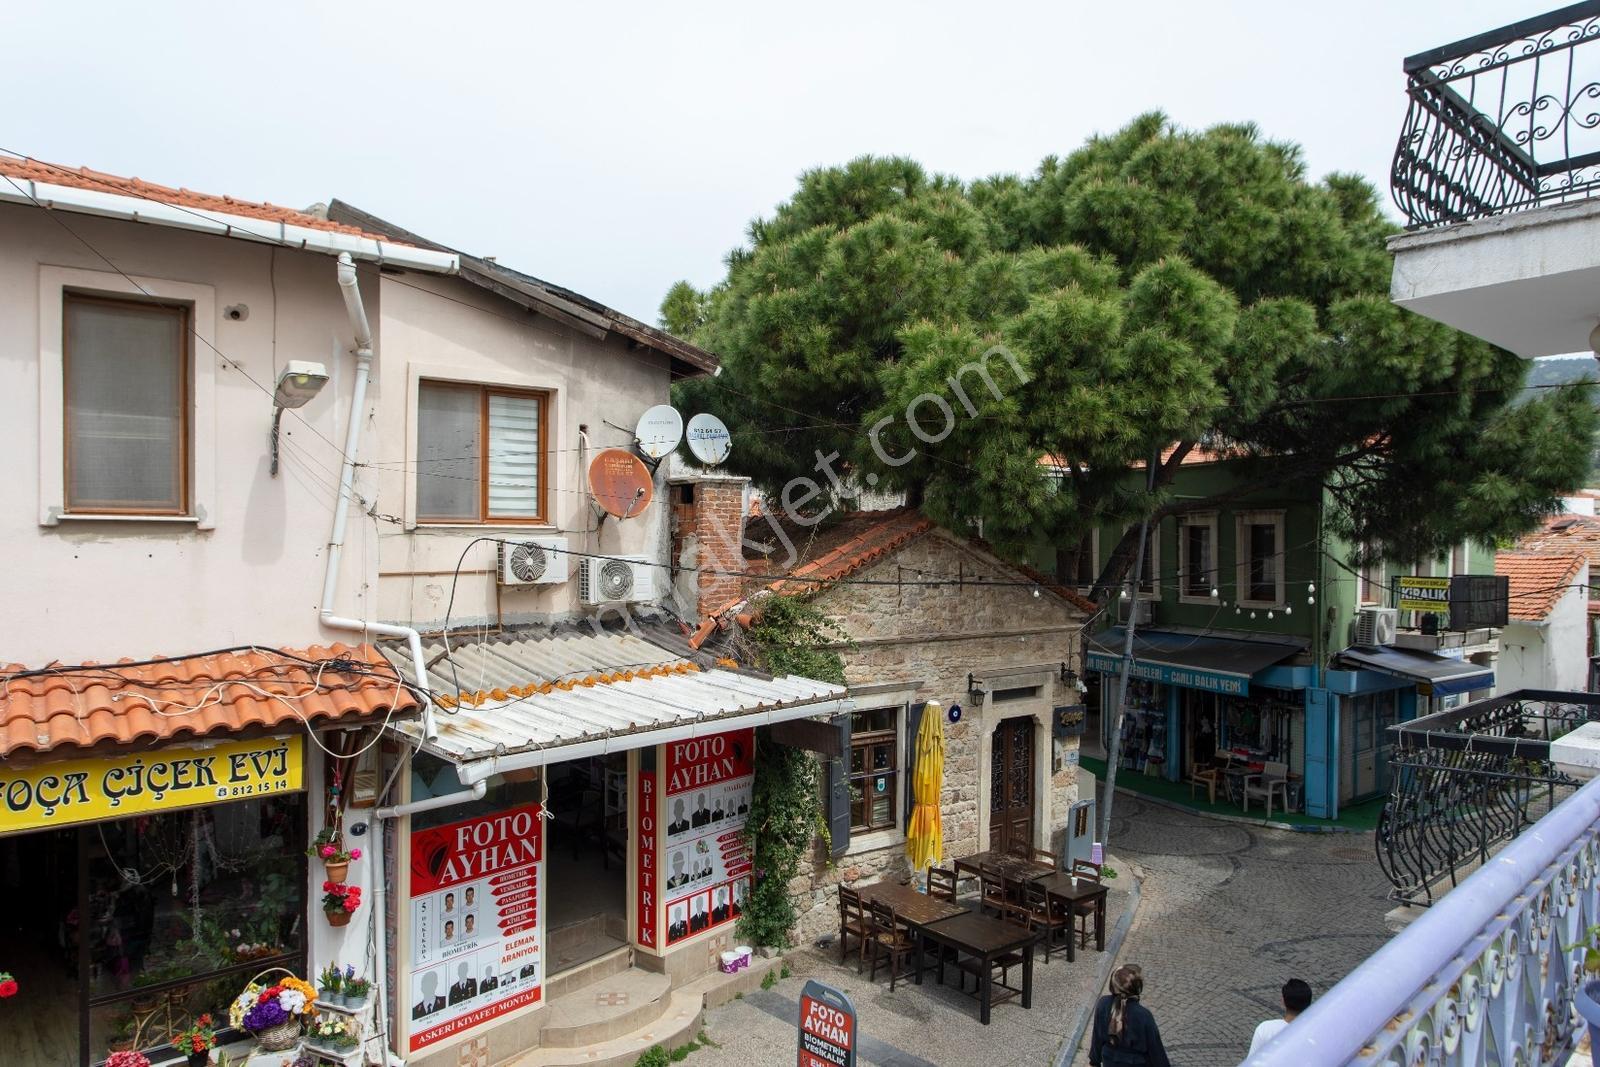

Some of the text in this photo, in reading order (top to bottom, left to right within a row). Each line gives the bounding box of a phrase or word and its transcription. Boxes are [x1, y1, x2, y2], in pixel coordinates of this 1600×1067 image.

[1170, 671, 1193, 685] CANLI
[673, 735, 726, 766] FOTO
[102, 756, 218, 808] ÇİÇEK
[231, 779, 288, 797] 812 15 14
[668, 755, 736, 793] AYHAN
[455, 812, 532, 853] FOTO
[438, 835, 539, 885] AYHAN
[501, 945, 539, 965] ARANIYOR
[505, 935, 535, 952] ELEMAN
[418, 1021, 456, 1045] ASKERİ
[456, 1006, 497, 1031] KIYAFET
[498, 991, 535, 1012] MONTAJ
[810, 1000, 845, 1028] FOTO
[804, 1015, 849, 1047] AYHAN
[804, 1033, 847, 1059] BİOMETRİK
[804, 1041, 845, 1067] VESİKALIK
